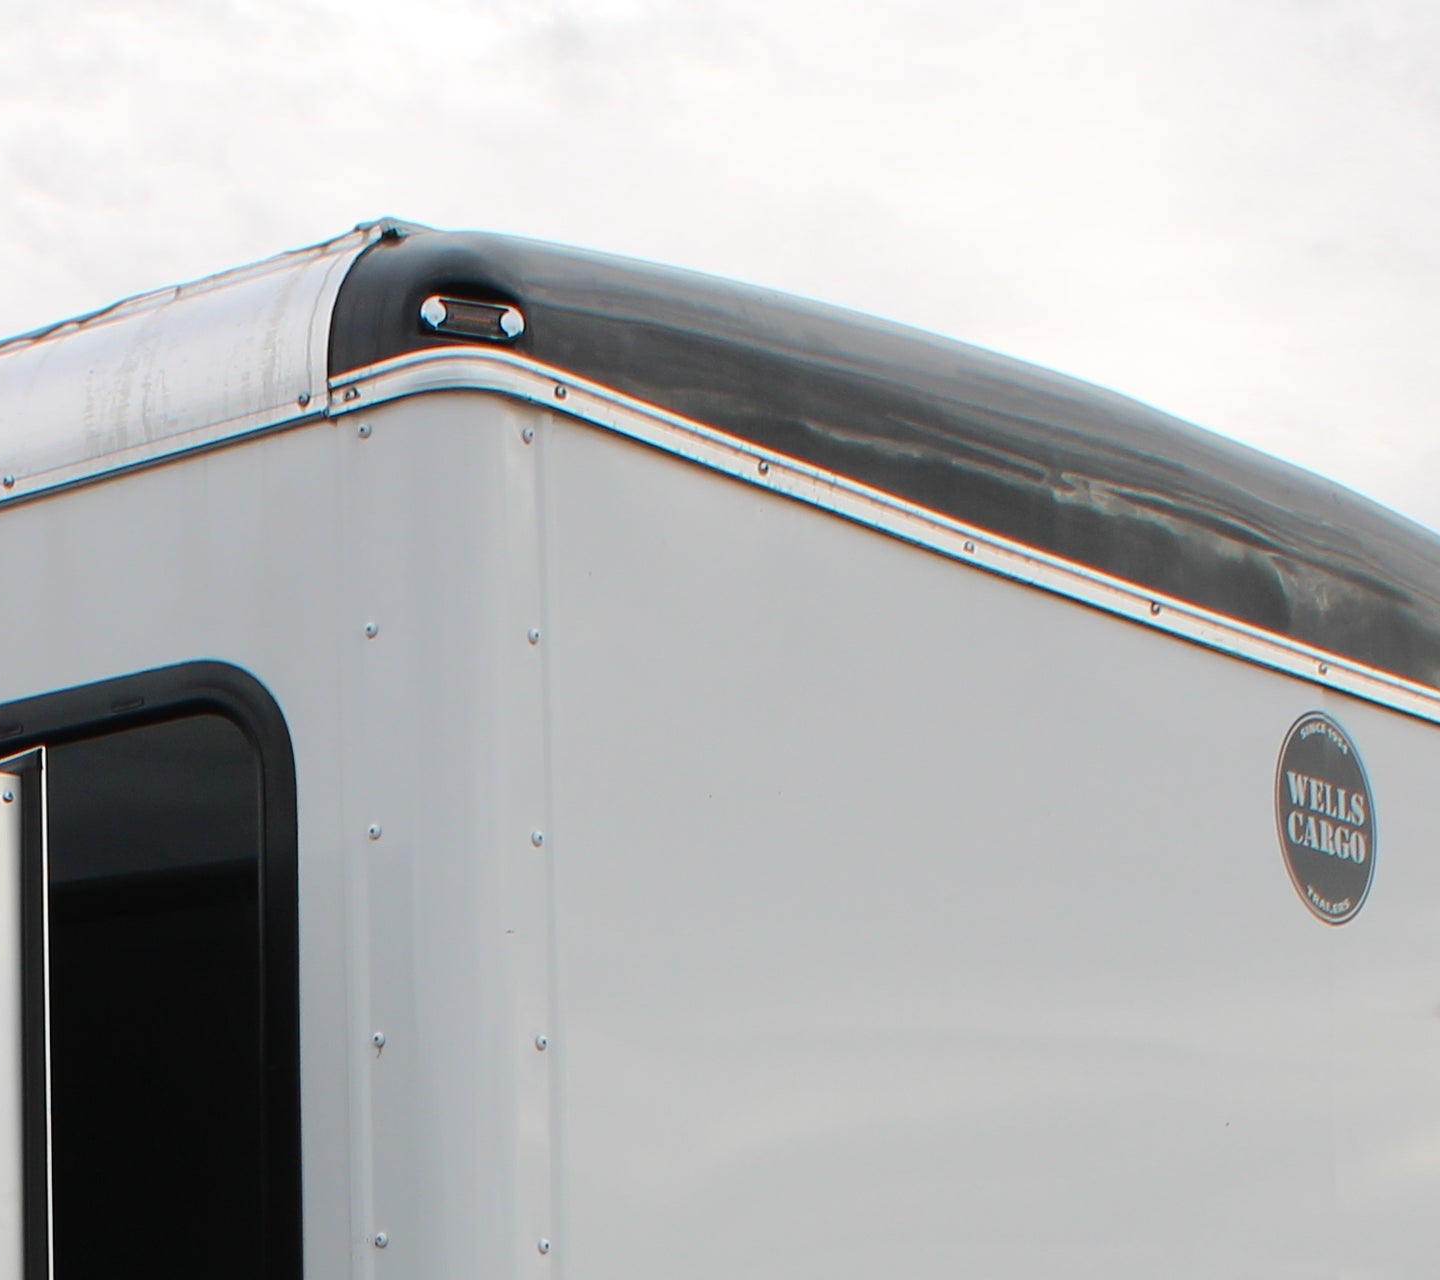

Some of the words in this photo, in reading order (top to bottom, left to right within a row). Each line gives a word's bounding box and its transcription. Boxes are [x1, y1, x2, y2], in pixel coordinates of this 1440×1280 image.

[1300, 721, 1326, 740] SINCE
[1286, 770, 1365, 826] WELLS
[1287, 810, 1367, 865] CARGO
[1307, 884, 1351, 915] TRAILERS
